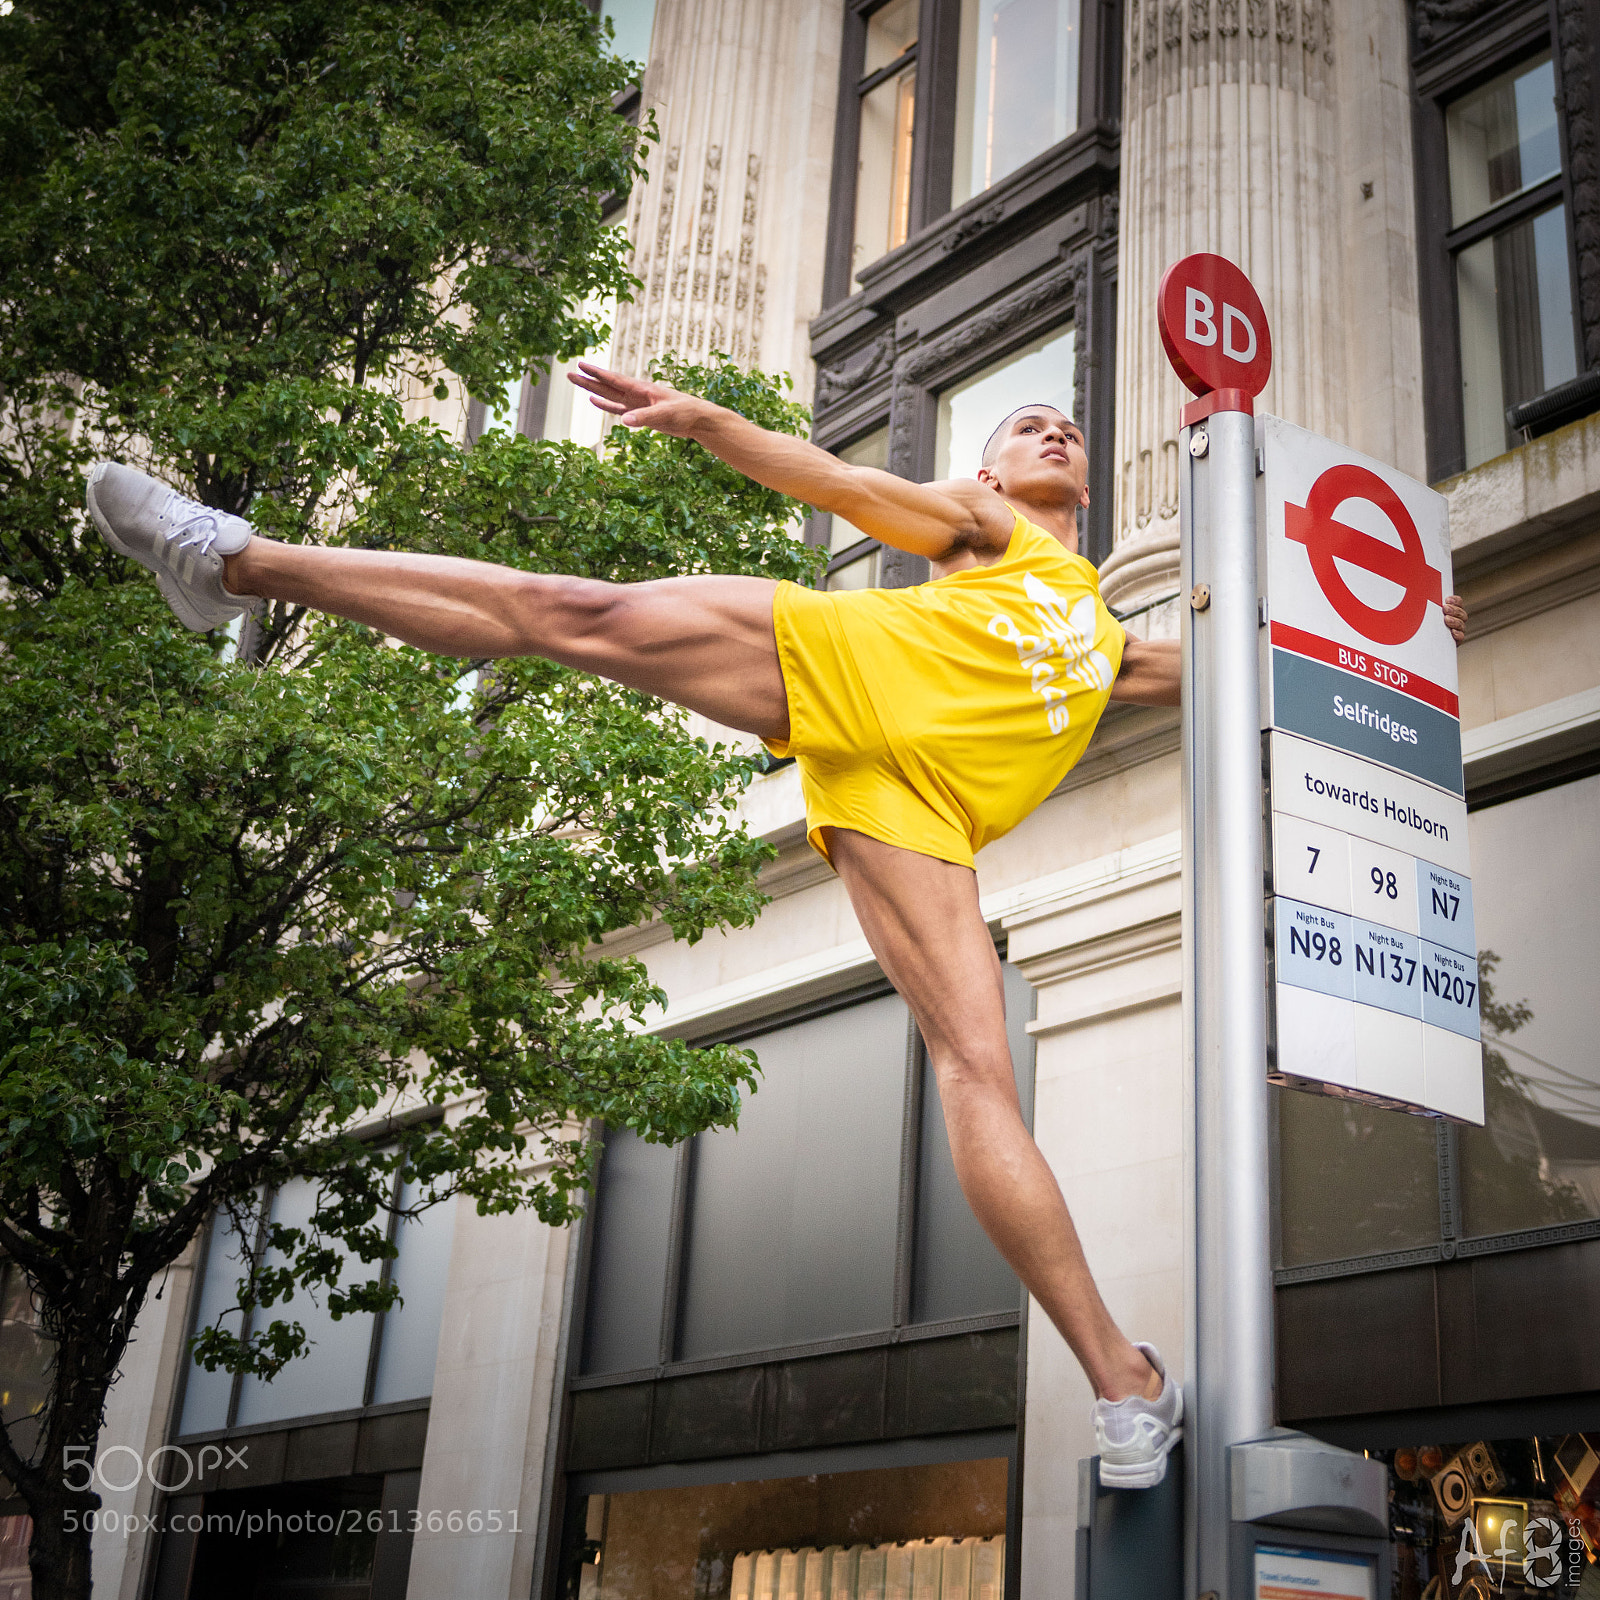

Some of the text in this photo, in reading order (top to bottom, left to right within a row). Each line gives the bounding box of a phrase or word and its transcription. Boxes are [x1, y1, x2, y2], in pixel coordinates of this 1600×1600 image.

[1185, 286, 1257, 363] BD
[987, 614, 1069, 735] adidas
[1338, 648, 1409, 688] BUS STOP
[1333, 695, 1418, 745] Selfridges
[1304, 772, 1449, 842] towards Holborn
[1307, 846, 1321, 874] 7
[1370, 866, 1398, 900] 98
[1430, 871, 1460, 892] Night Bus
[1296, 911, 1335, 930] Night Bus
[1431, 887, 1460, 922] N7
[1290, 926, 1342, 966] N98
[1368, 931, 1404, 950] Night Bus
[1355, 943, 1417, 987] N137
[1434, 952, 1465, 972] Night Bus
[1423, 964, 1476, 1008] N207
